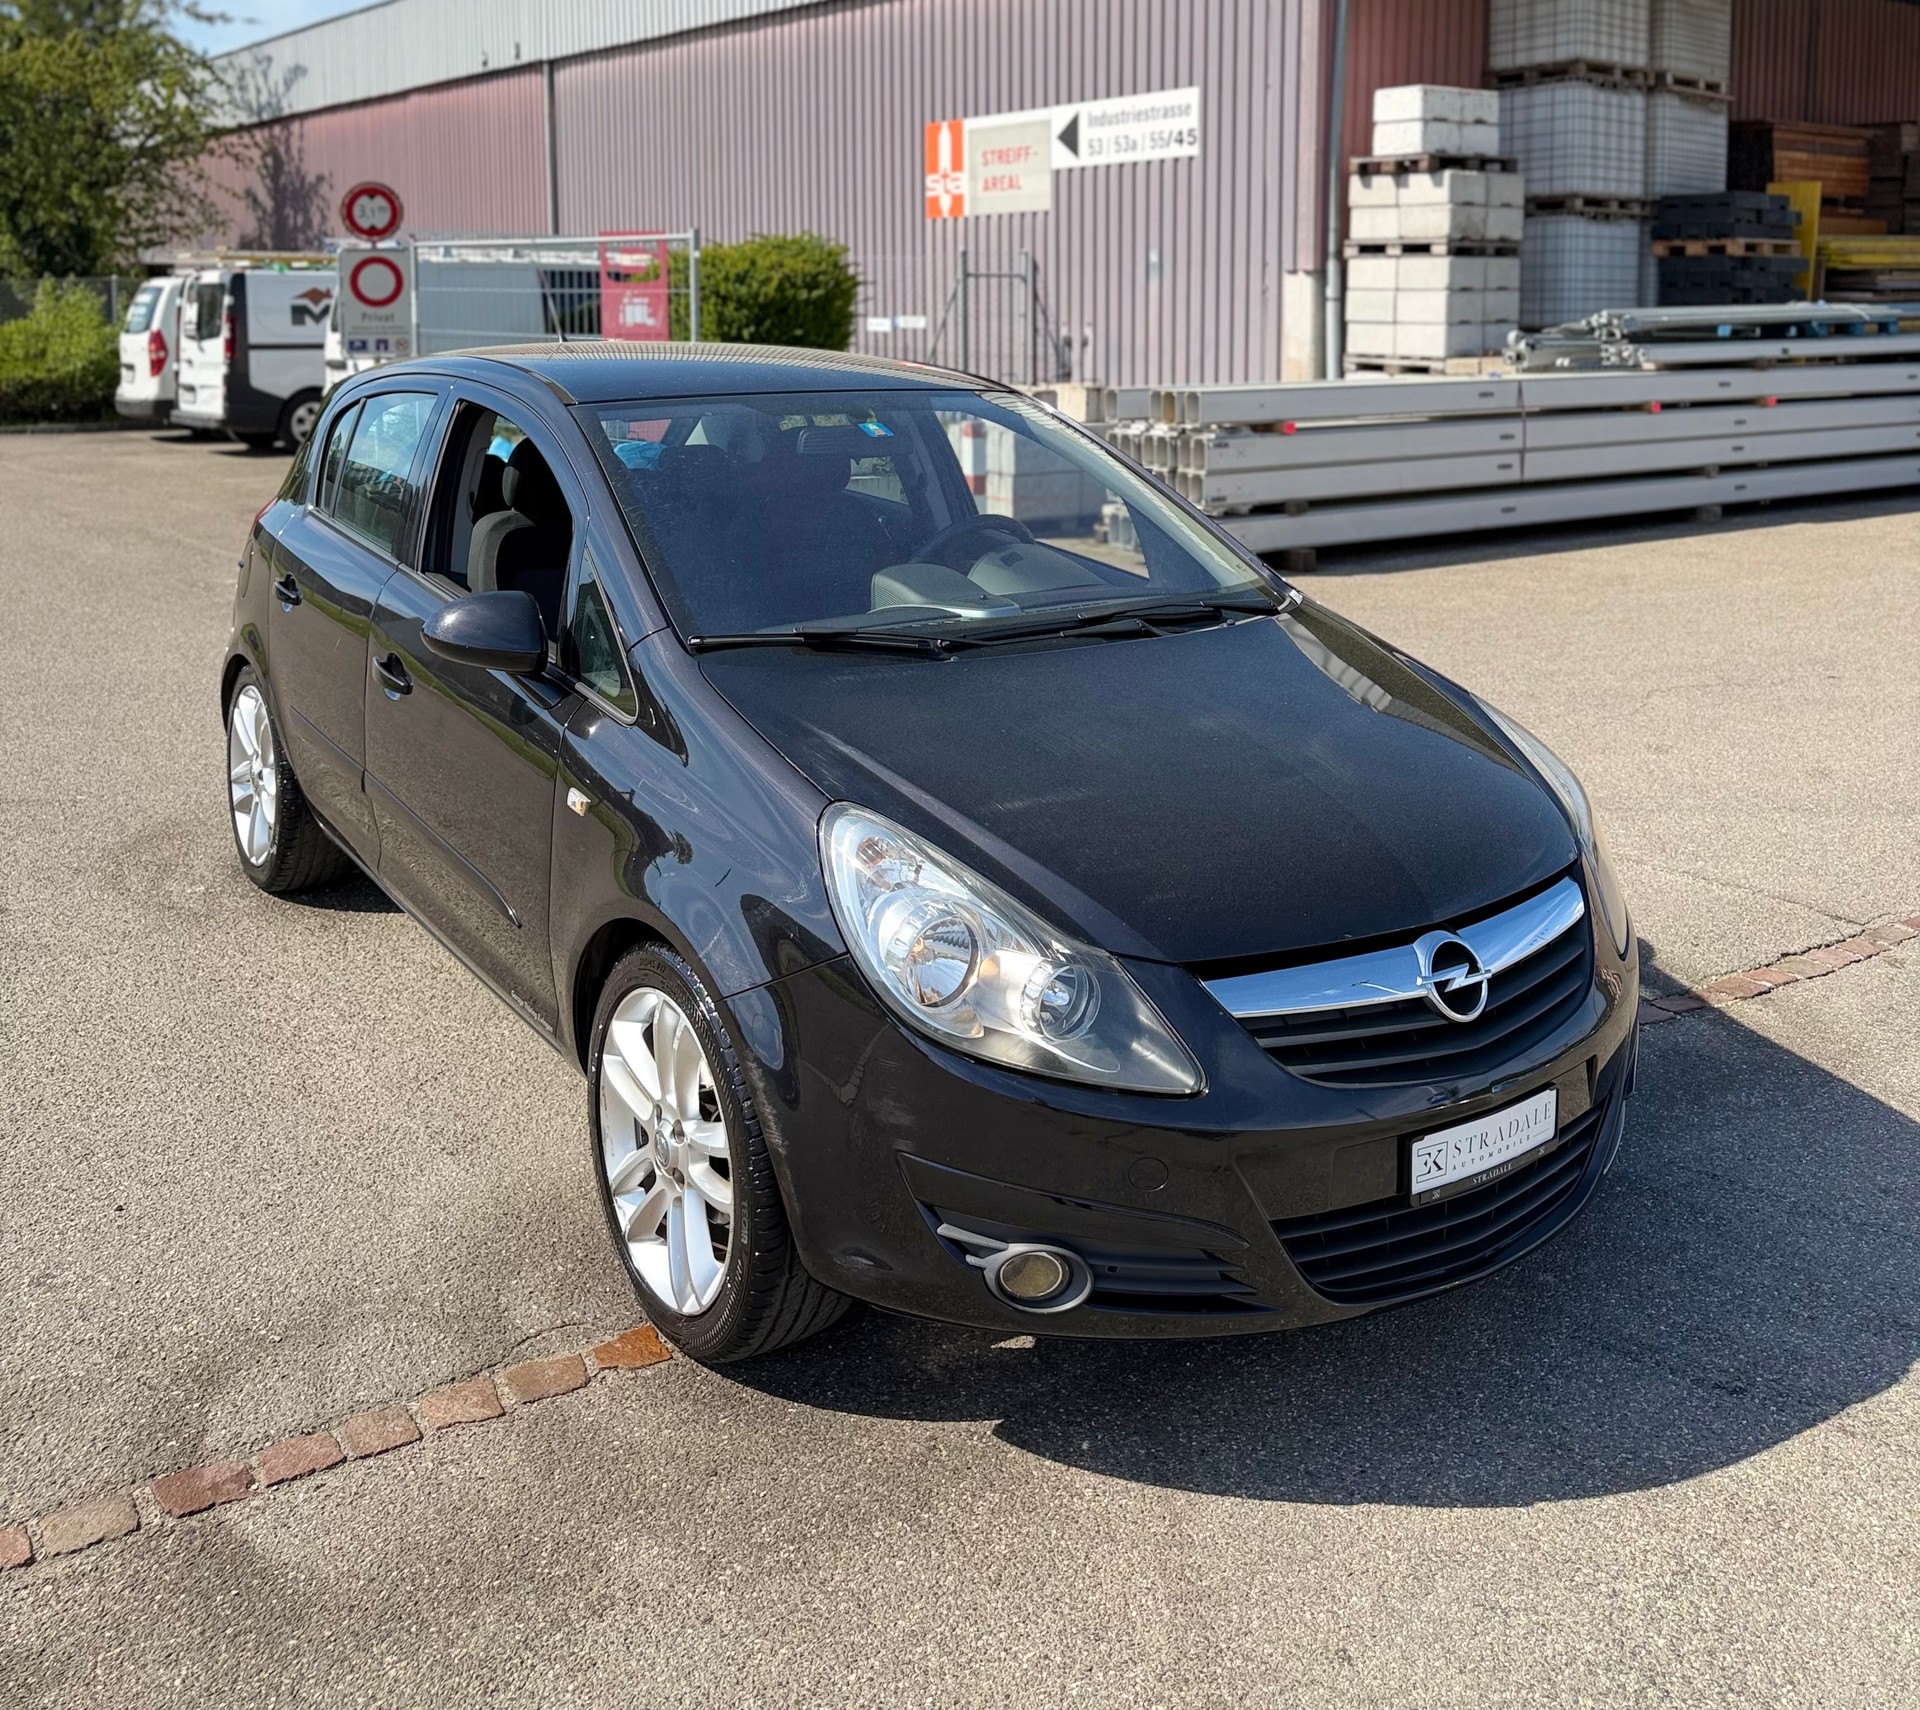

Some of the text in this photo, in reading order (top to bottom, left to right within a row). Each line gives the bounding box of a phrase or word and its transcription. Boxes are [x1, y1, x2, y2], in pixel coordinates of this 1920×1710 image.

[1087, 103, 1192, 128] Industriestrasse
[981, 145, 1039, 167] STREIFF-
[1088, 138, 1103, 156] 53
[1114, 134, 1137, 153] 53a
[982, 174, 1022, 192] AREAL
[361, 312, 395, 322] Privat
[1452, 1101, 1552, 1159] STRADALE
[1472, 1162, 1513, 1185] STRADALE
